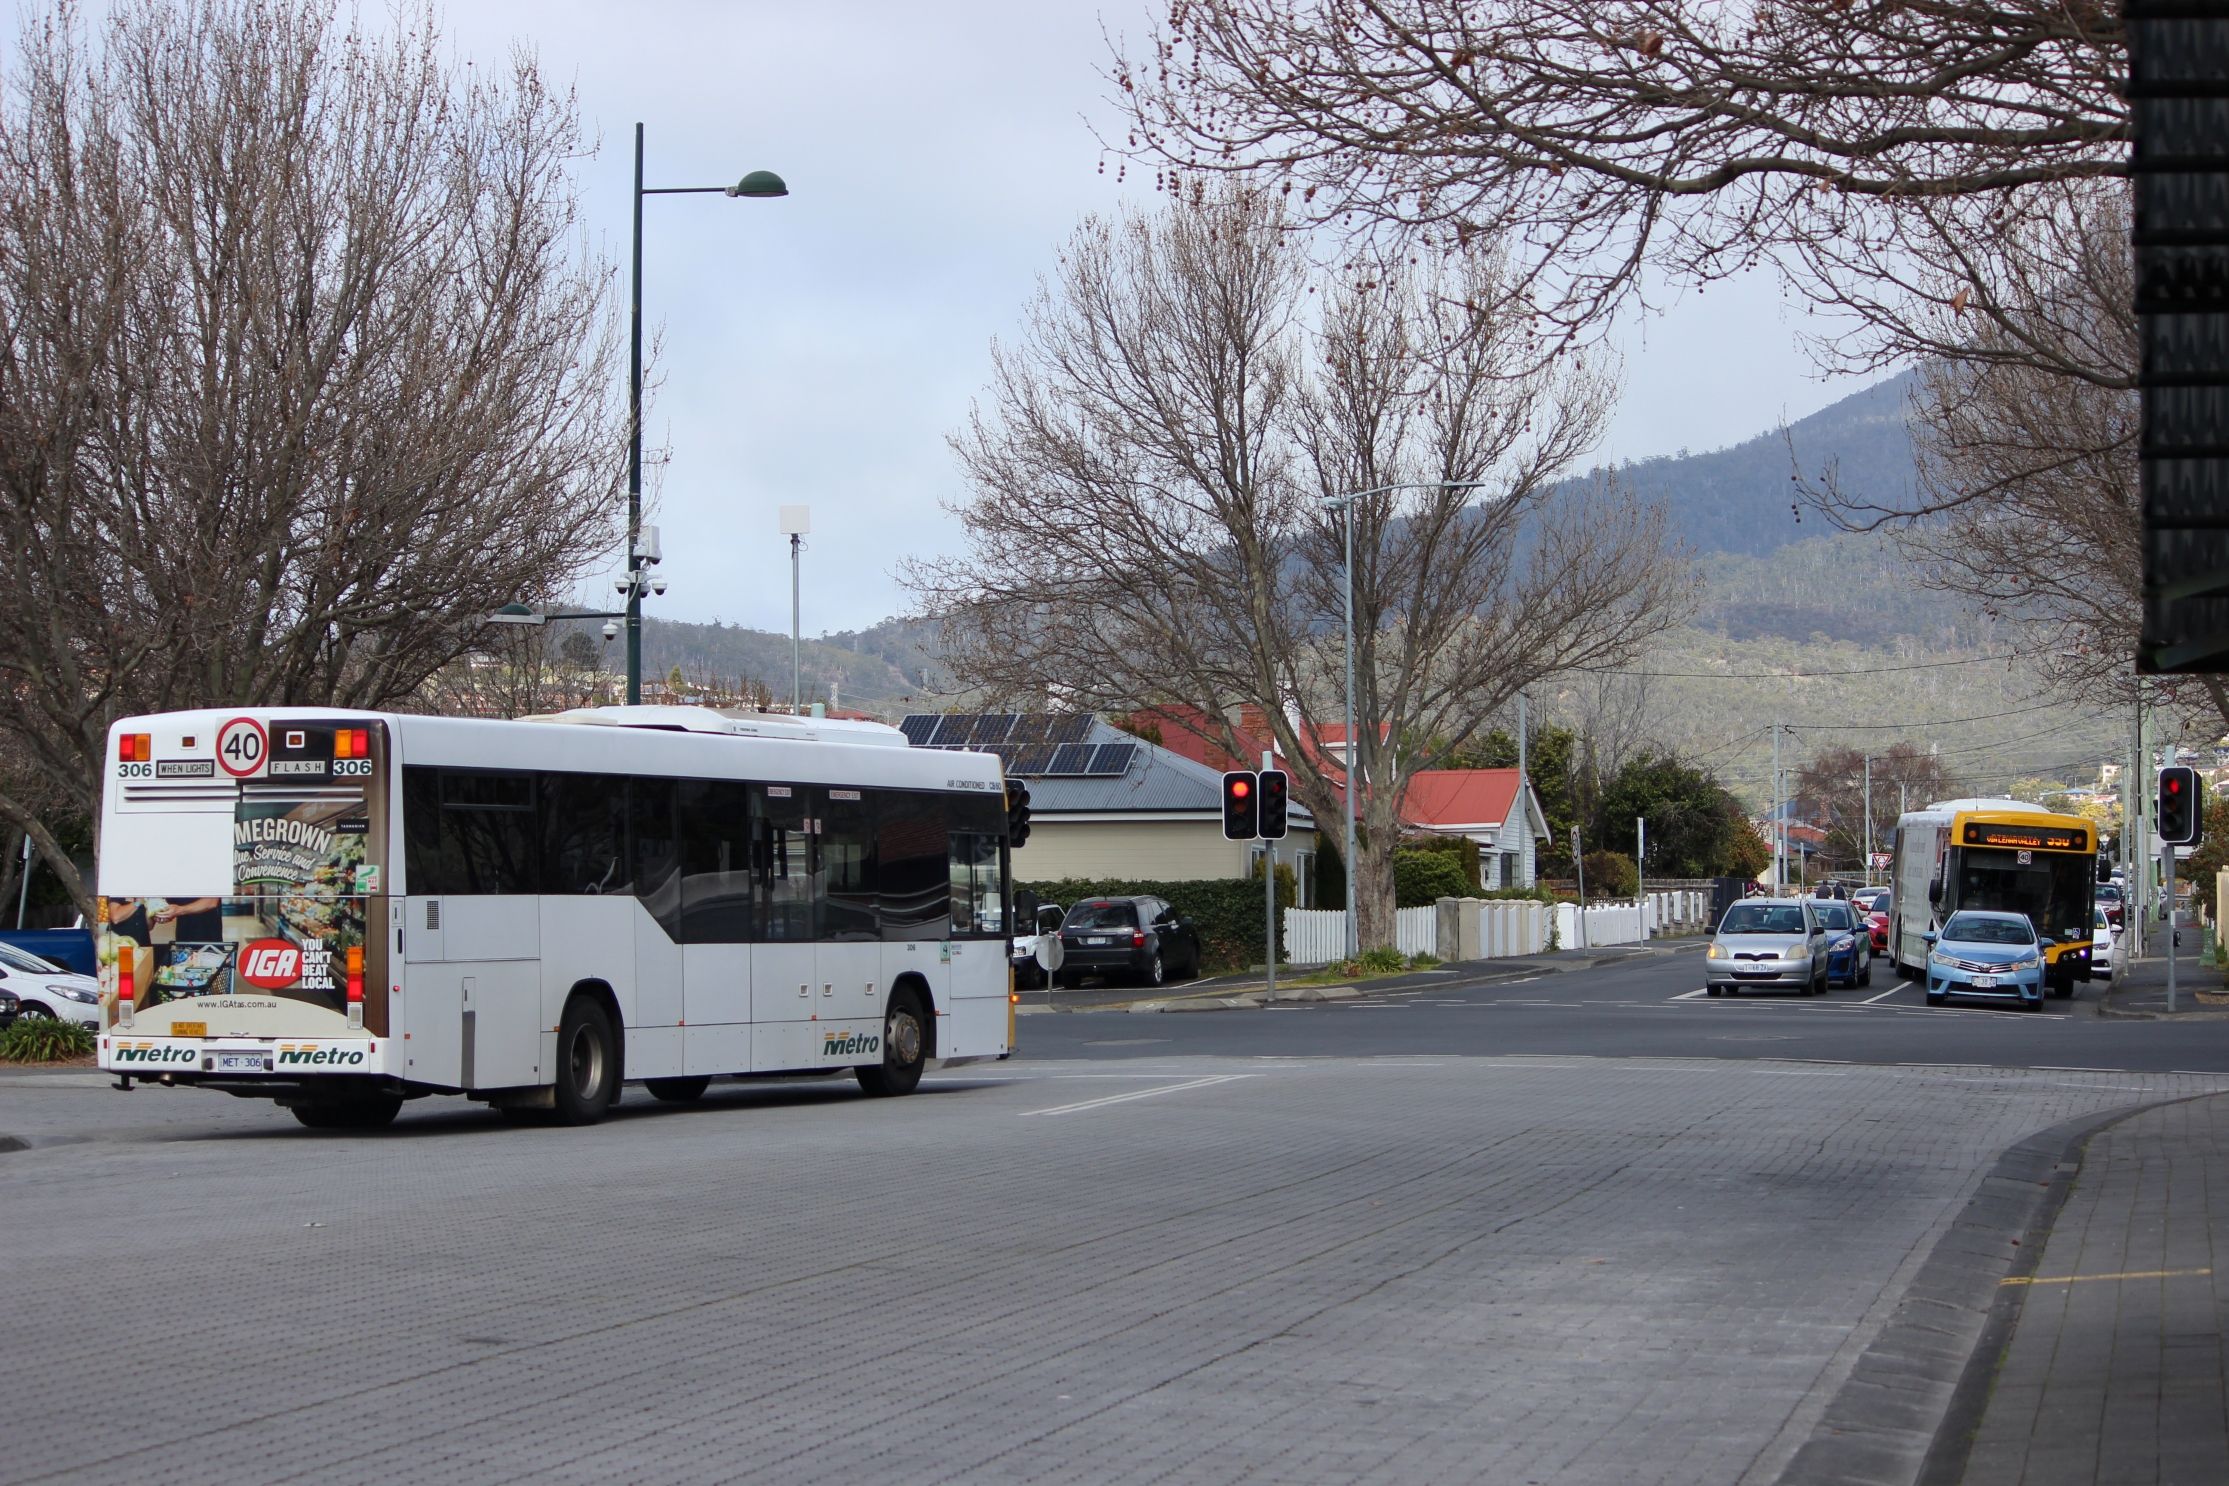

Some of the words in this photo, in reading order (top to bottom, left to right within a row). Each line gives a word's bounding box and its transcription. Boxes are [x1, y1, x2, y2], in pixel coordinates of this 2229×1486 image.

[224, 733, 259, 761] 40
[118, 763, 152, 777] 306
[161, 764, 183, 774] WHEN
[186, 763, 210, 773] LIGHTS
[274, 762, 322, 773] FLASH
[333, 760, 371, 775] 306
[947, 780, 955, 788] AIR
[956, 780, 985, 790] CONDITIONED
[253, 844, 292, 862] Service
[292, 853, 316, 871] and
[238, 861, 299, 881] Convenience
[302, 938, 323, 951] YOU
[907, 943, 916, 951] 306
[244, 949, 299, 977] IGA
[301, 951, 333, 964] CAN'T
[302, 964, 328, 977] BEAT
[302, 976, 336, 990] LOCAL
[197, 1000, 277, 1009] www.IGAtas.com.au
[823, 1031, 879, 1056] Metro
[115, 1042, 196, 1063] Metro
[278, 1043, 364, 1065] Metro
